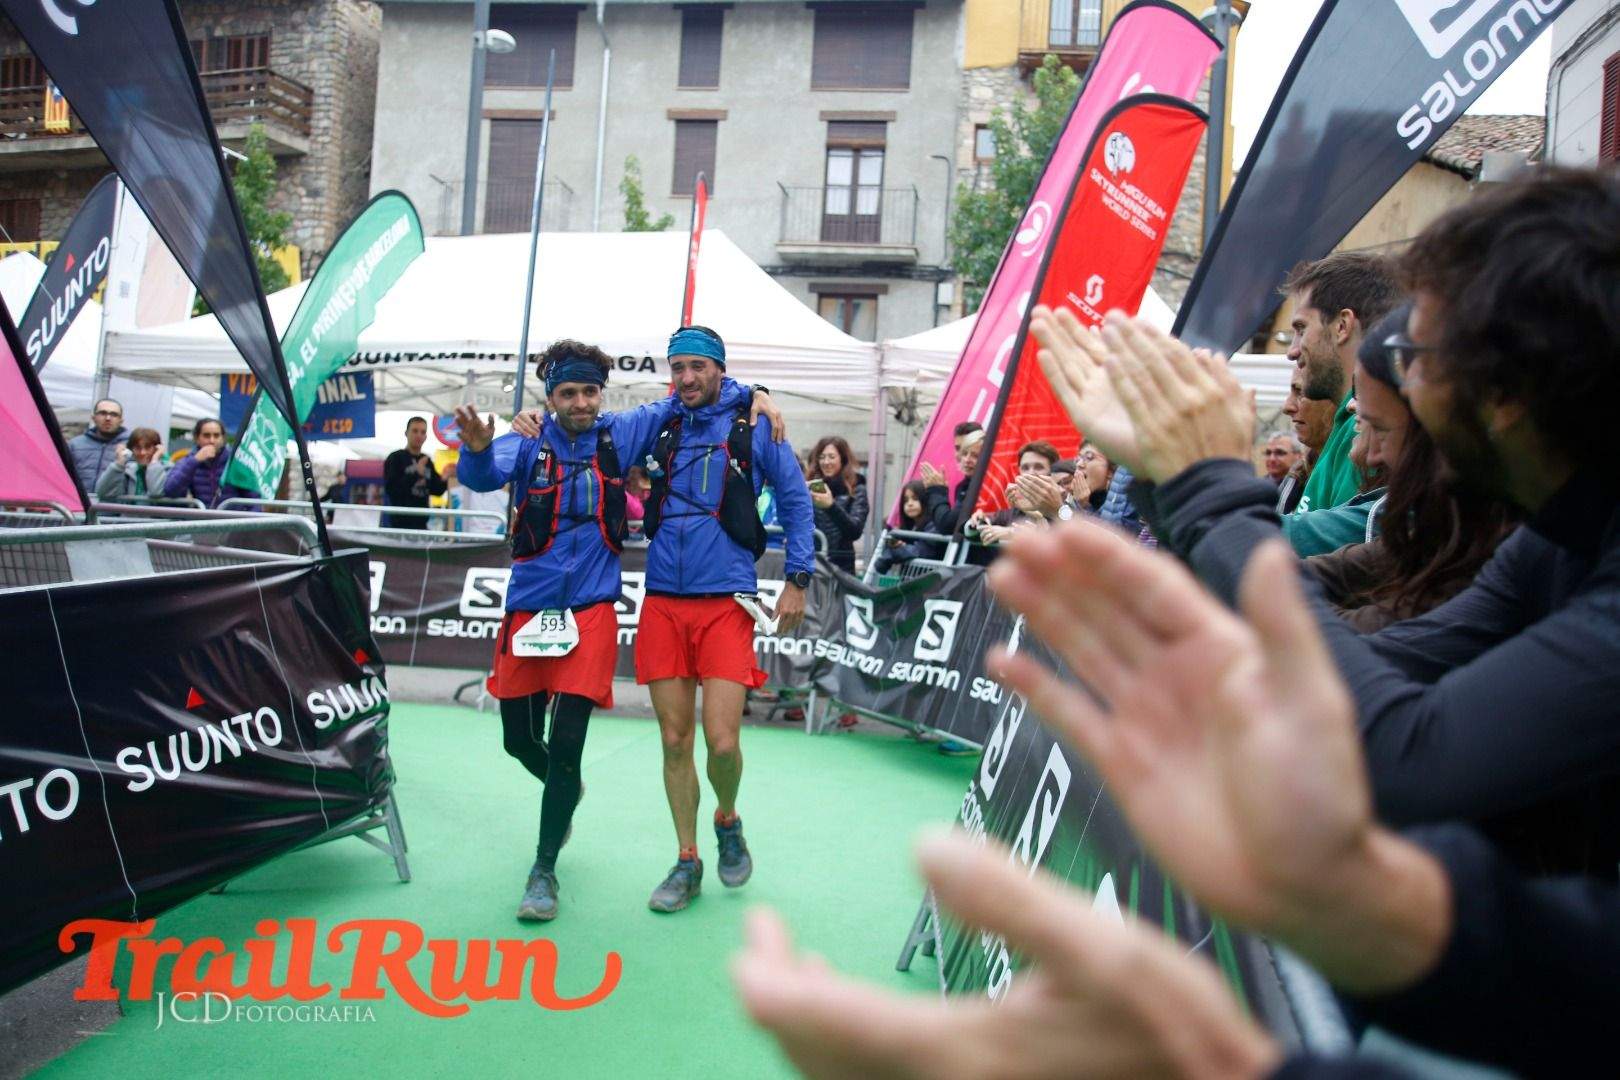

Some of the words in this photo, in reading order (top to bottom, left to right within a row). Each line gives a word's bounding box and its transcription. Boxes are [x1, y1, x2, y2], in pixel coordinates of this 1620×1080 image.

[1102, 193, 1131, 221] WORLD
[26, 236, 110, 366] SUUNTO
[317, 373, 367, 405] INAL
[541, 617, 567, 632] 593
[753, 635, 813, 656] mon
[0, 768, 80, 834] TO
[116, 706, 283, 793] SUUNTO
